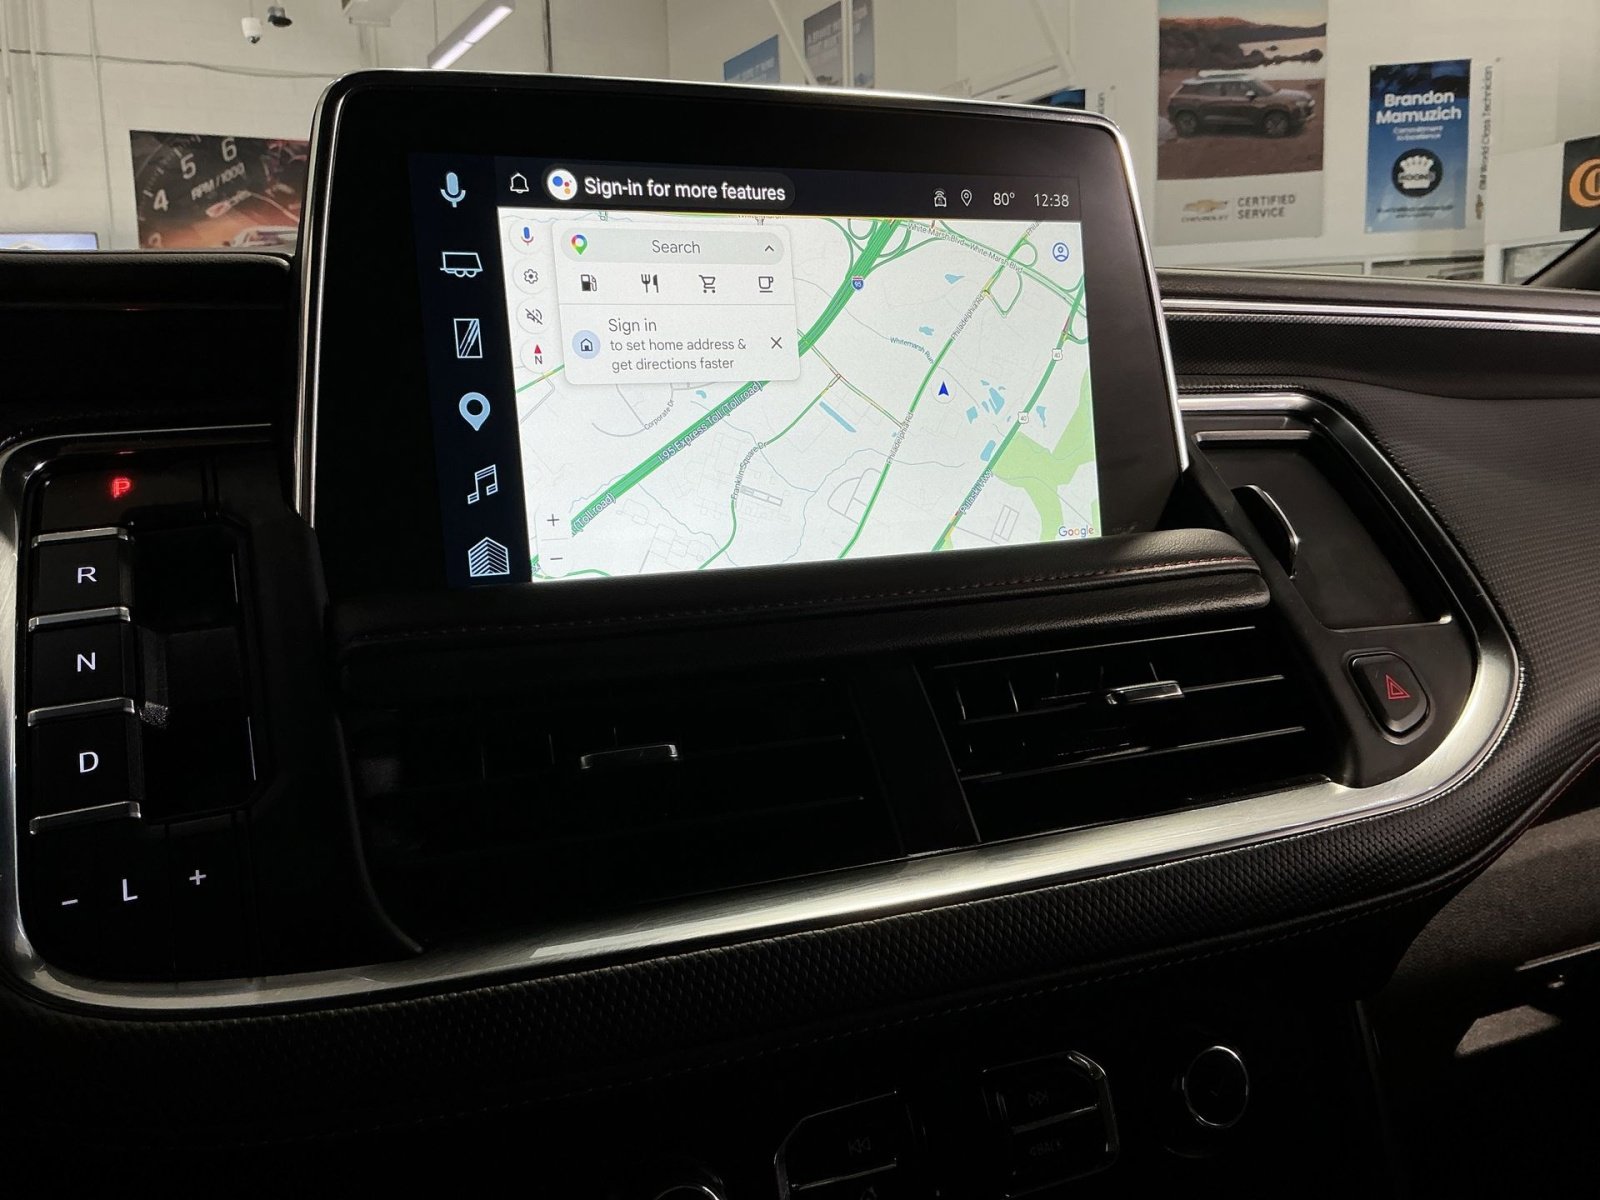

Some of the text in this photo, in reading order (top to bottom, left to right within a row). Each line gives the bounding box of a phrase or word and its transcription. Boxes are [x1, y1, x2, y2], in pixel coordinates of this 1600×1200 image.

[1384, 90, 1454, 107] Brandon
[1483, 66, 1492, 120] Technician
[1376, 107, 1462, 125] Mamuzich
[1481, 122, 1491, 148] Class
[222, 138, 237, 162] 6
[180, 153, 196, 179] 5
[585, 177, 785, 200] Sign-in for more features
[154, 189, 169, 211] 4
[1034, 194, 1069, 207] 12:38
[1238, 194, 1296, 207] CERTIFIED
[1238, 207, 1284, 219] SERVICE
[652, 239, 700, 254] Search
[609, 319, 656, 334] Sign in
[951, 301, 978, 340] Philadelphia
[610, 339, 746, 351] to set home address &
[534, 355, 543, 364] N
[612, 358, 734, 372] get directions faster
[644, 402, 672, 430] Corporate
[675, 421, 708, 451] Express
[706, 408, 723, 428] Toll
[887, 421, 910, 464] Philadelphia
[731, 468, 743, 500] Franklin
[740, 447, 759, 469] Square
[112, 479, 130, 497] P
[1058, 525, 1094, 538] Google
[77, 567, 97, 584] R
[76, 652, 96, 672] N
[79, 751, 99, 773] D
[123, 878, 138, 901] L
